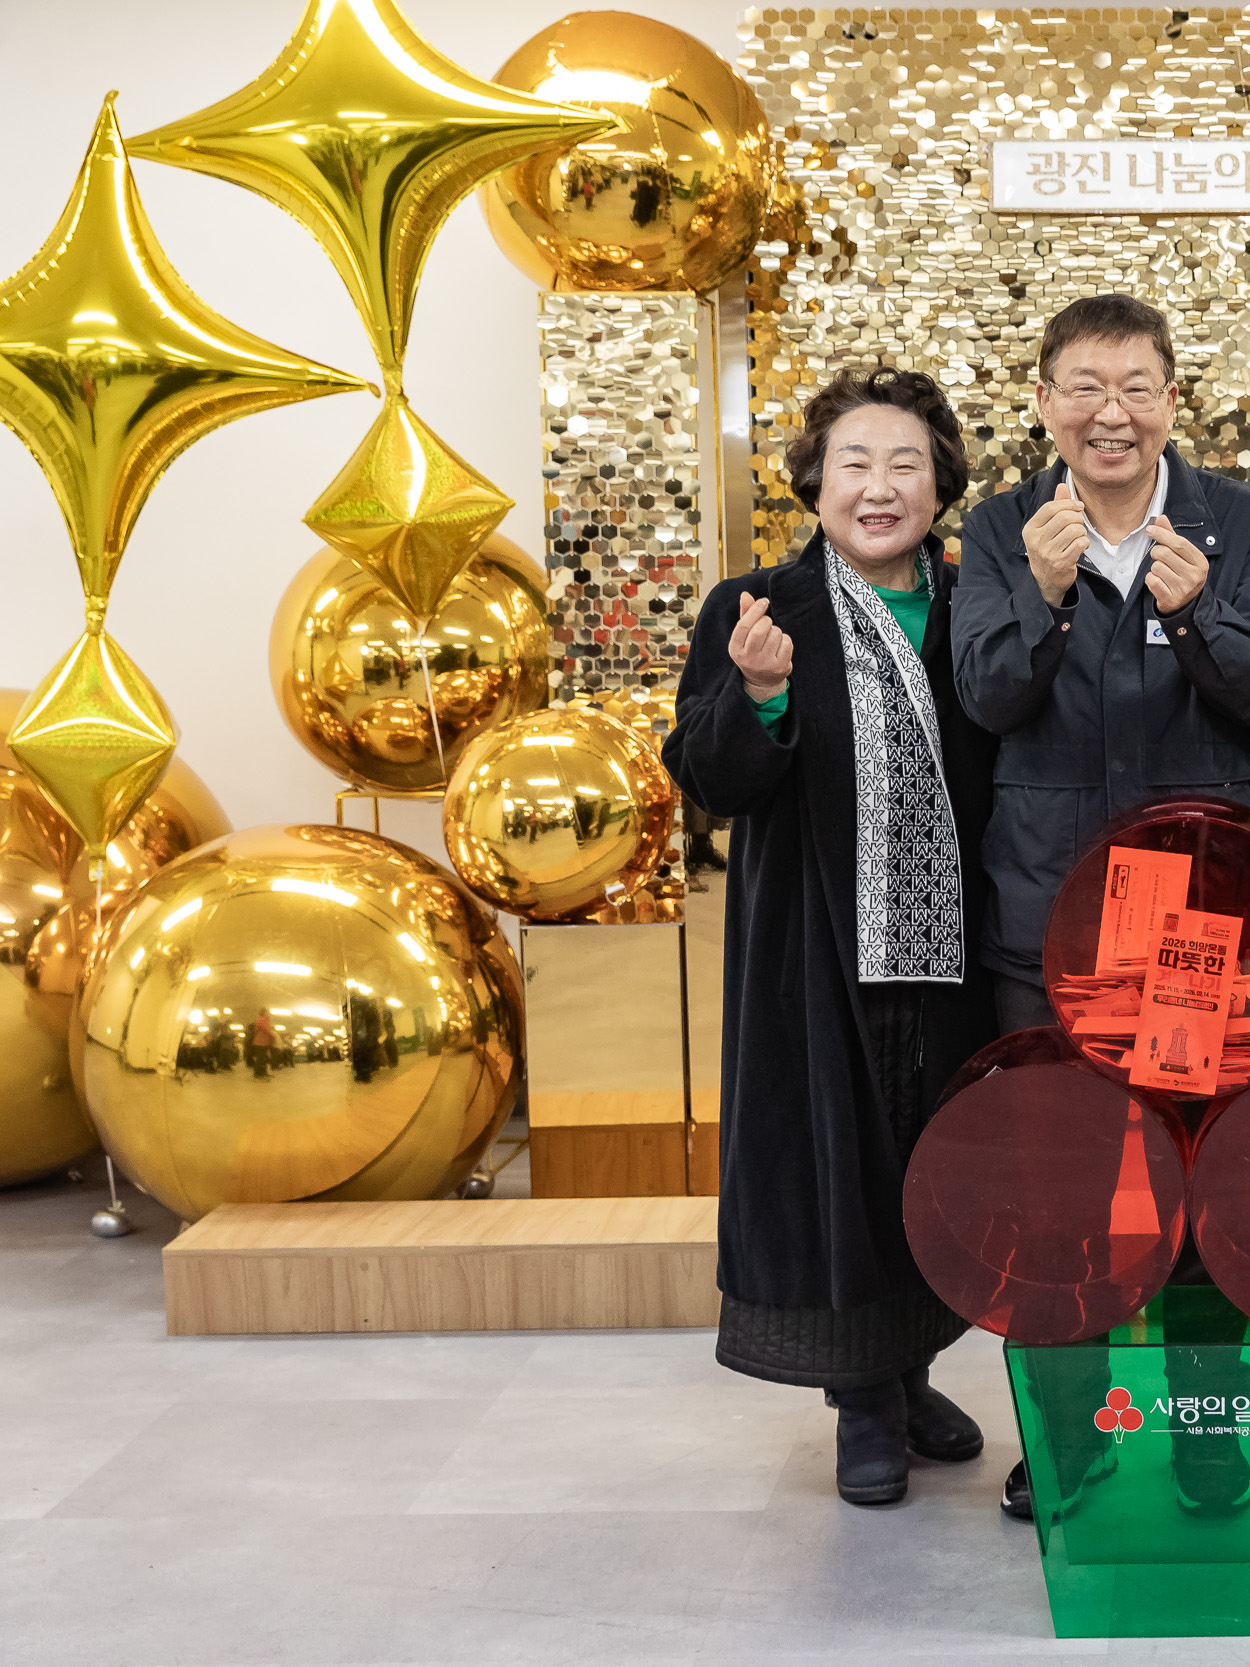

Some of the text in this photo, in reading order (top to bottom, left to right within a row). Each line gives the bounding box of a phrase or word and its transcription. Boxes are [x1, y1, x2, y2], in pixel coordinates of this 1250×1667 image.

[1026, 150, 1112, 195] 광진
[1162, 937, 1186, 949] 2026
[1158, 948, 1225, 976] 따뜻한
[1149, 1396, 1226, 1424] 사랑의
[1186, 1426, 1203, 1435] 서울
